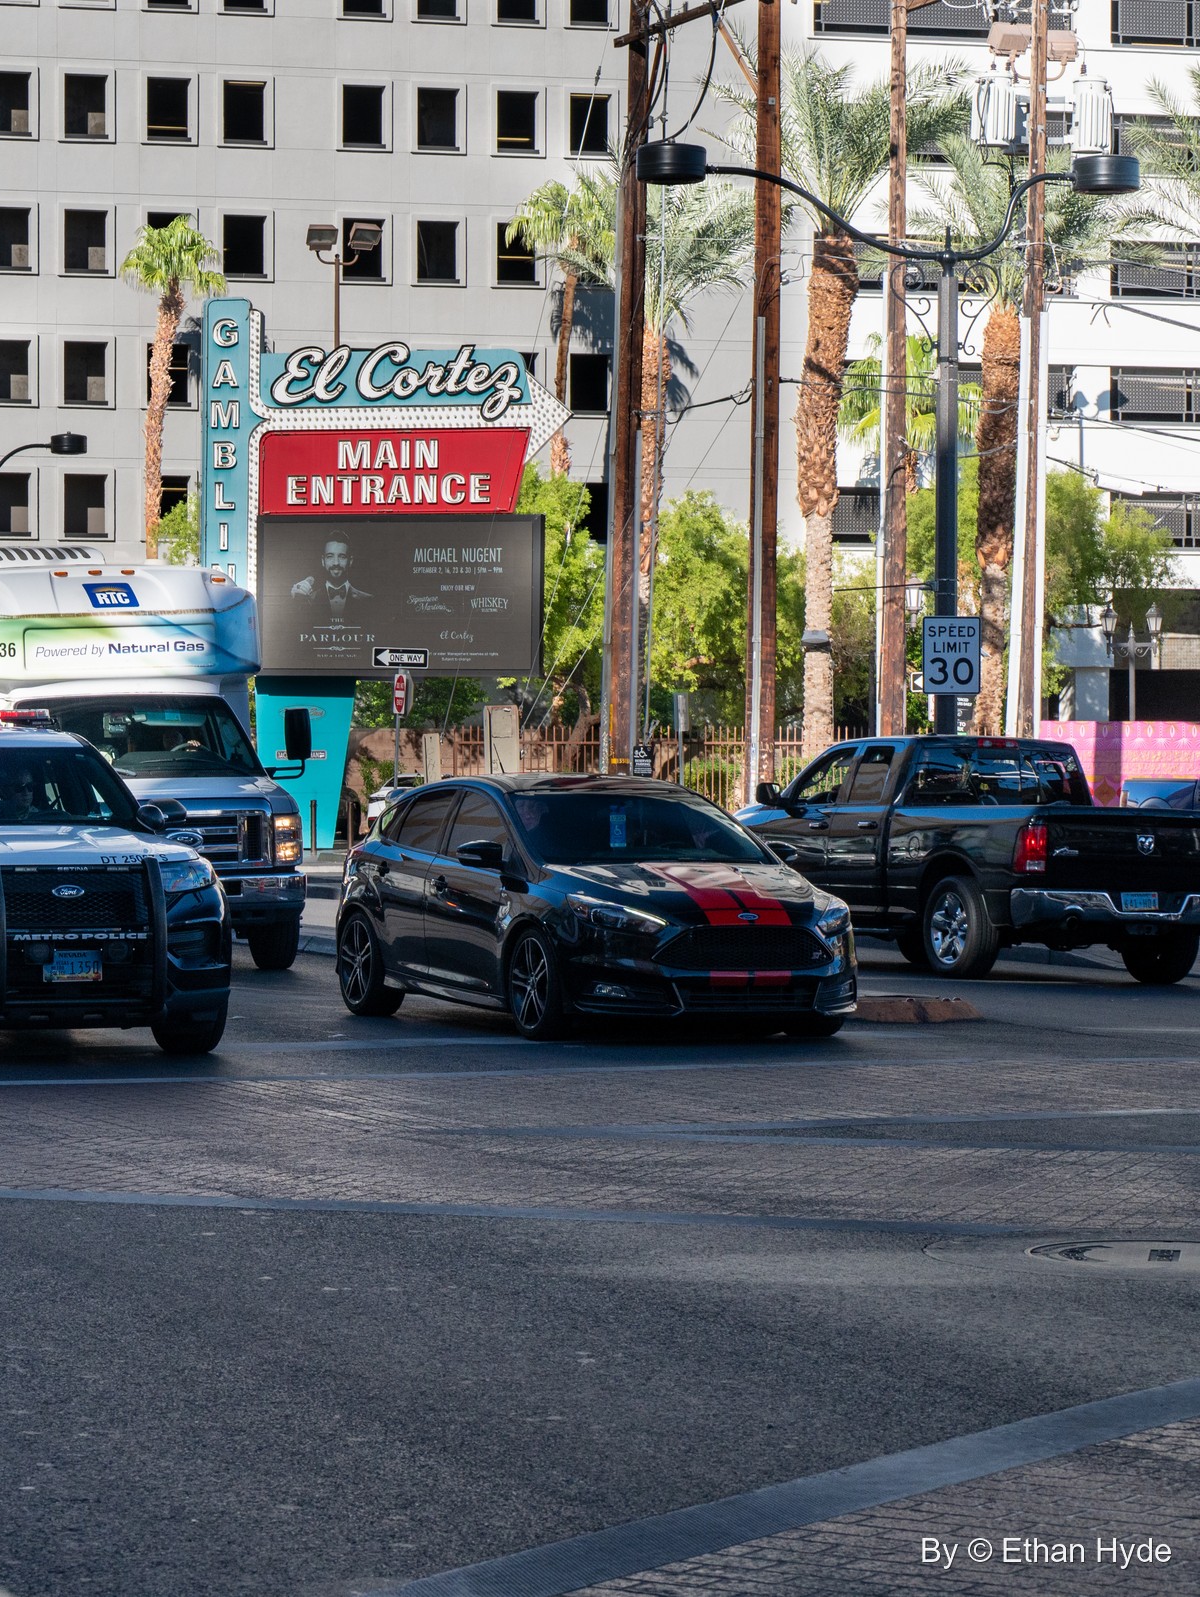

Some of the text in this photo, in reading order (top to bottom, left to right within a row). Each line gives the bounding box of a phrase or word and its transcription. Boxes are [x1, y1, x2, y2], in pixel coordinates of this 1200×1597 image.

[270, 341, 524, 421] El Cortez
[210, 318, 240, 586] GAMBLIN
[337, 439, 440, 471] MAIN
[286, 473, 492, 506] ENTRANCE
[413, 547, 503, 563] MICHAEL NUGENT
[95, 591, 130, 605] RTC
[470, 597, 509, 609] WHISKEY
[299, 634, 376, 642] PARLOUR
[928, 625, 976, 638] SPEED
[35, 643, 87, 658] Powered
[91, 642, 105, 657] by
[108, 641, 170, 655] Natural
[173, 640, 205, 652] Gas
[933, 641, 971, 653] LIMIT
[389, 654, 423, 662] ONE WAY
[928, 657, 974, 686] 30
[100, 855, 118, 864] DT
[159, 853, 169, 862] S
[60, 887, 78, 896] Ford
[13, 932, 148, 941] METRO POLICE
[70, 960, 99, 975] 1350
